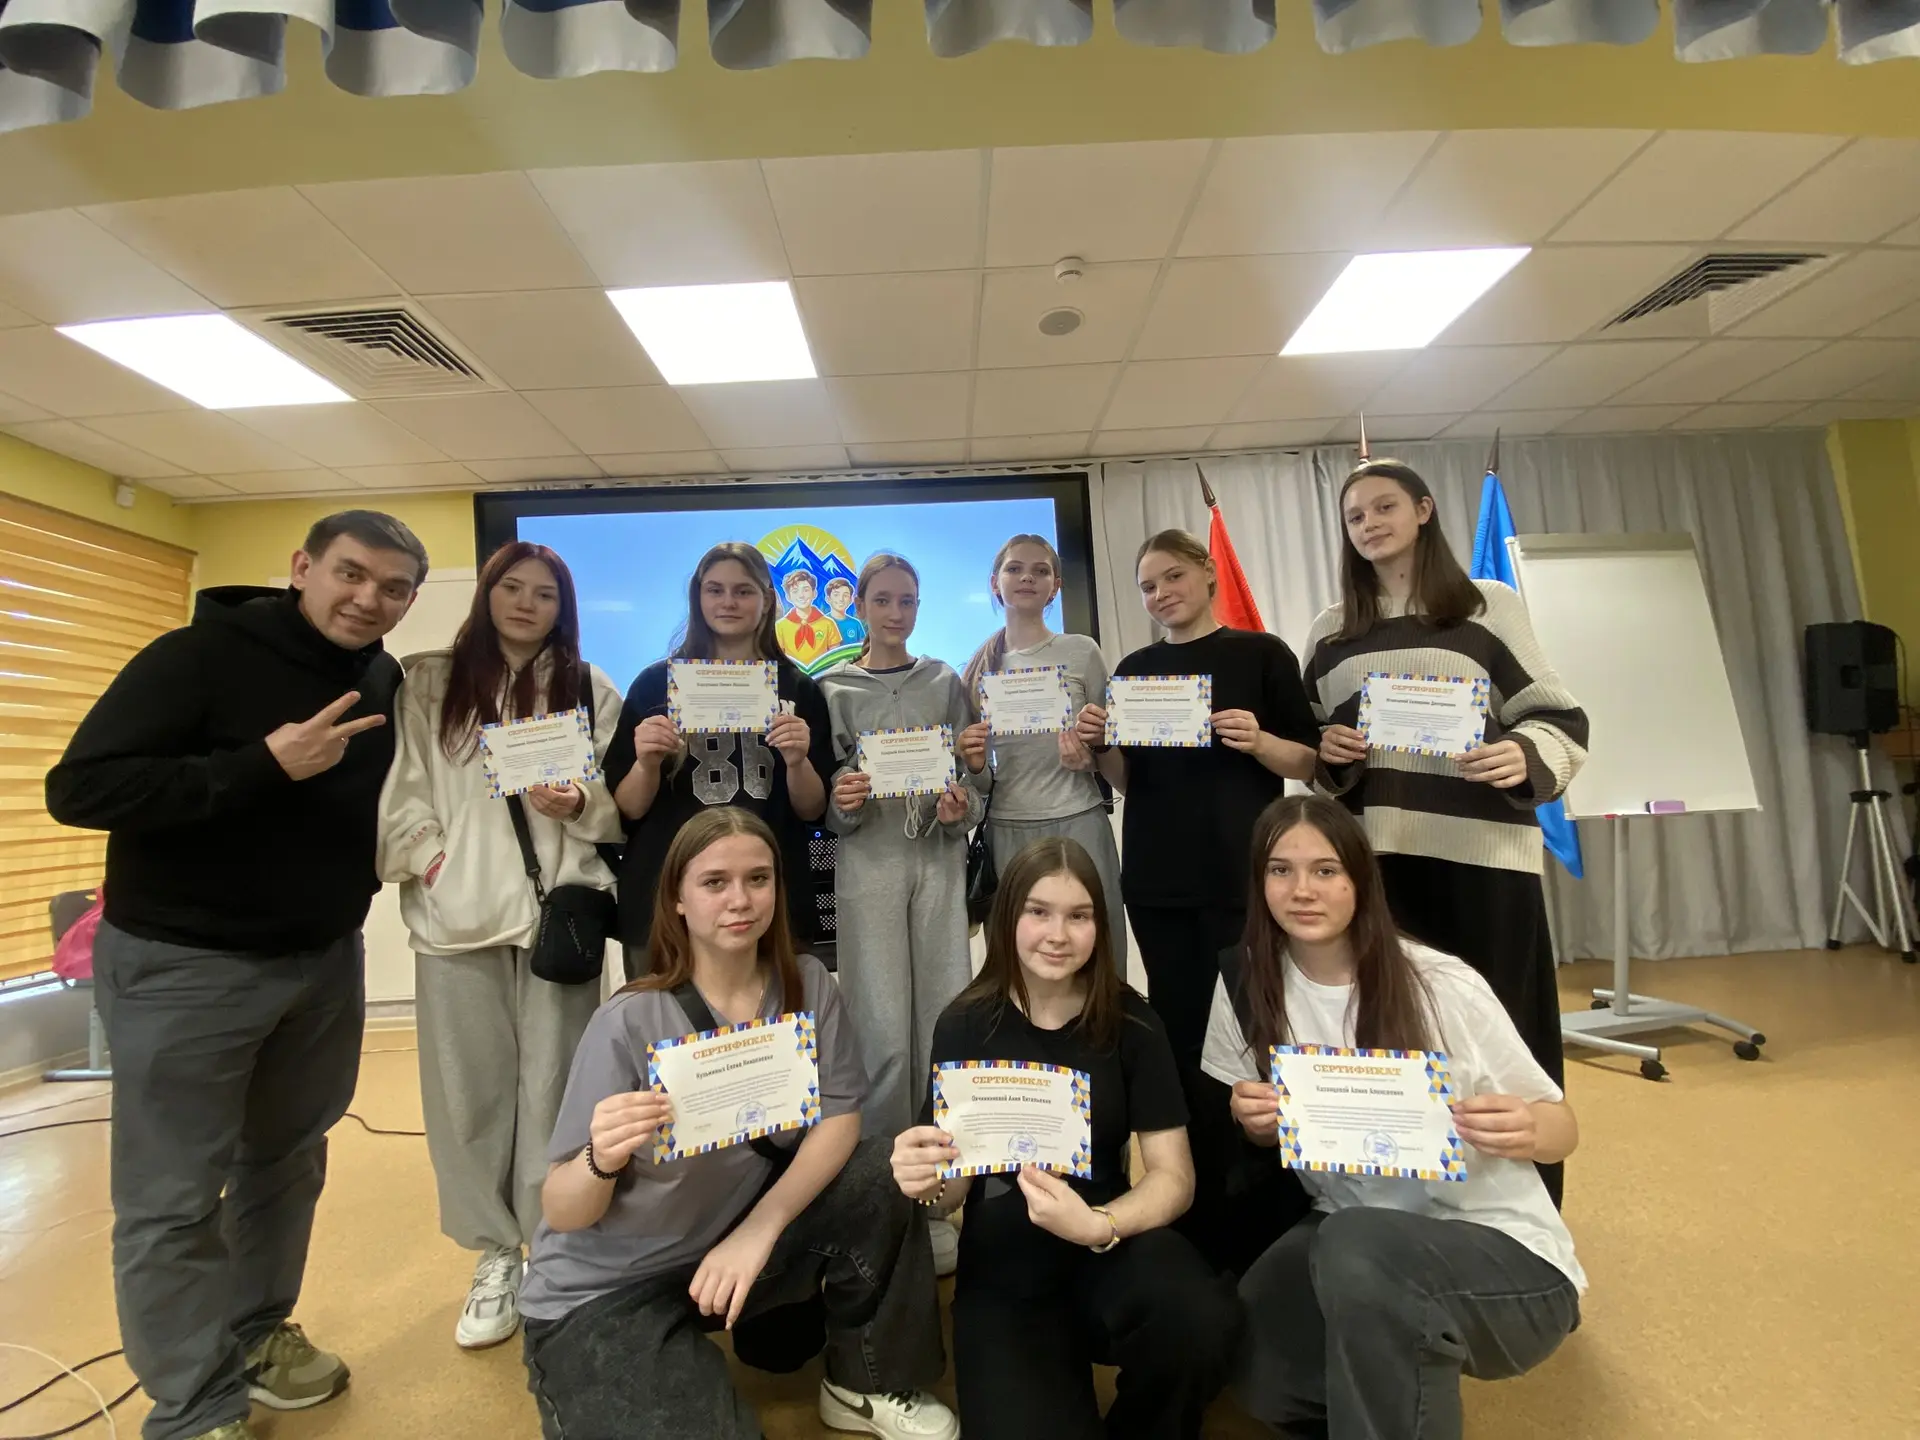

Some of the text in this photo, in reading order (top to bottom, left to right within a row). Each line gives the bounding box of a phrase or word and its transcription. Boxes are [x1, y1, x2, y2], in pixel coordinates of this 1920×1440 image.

[693, 1034, 774, 1060] СЕРТИФИКАТ
[1313, 1064, 1402, 1076] СЕРТИФИКАТ
[972, 1076, 1052, 1087] СЕРТИФИКАТ
